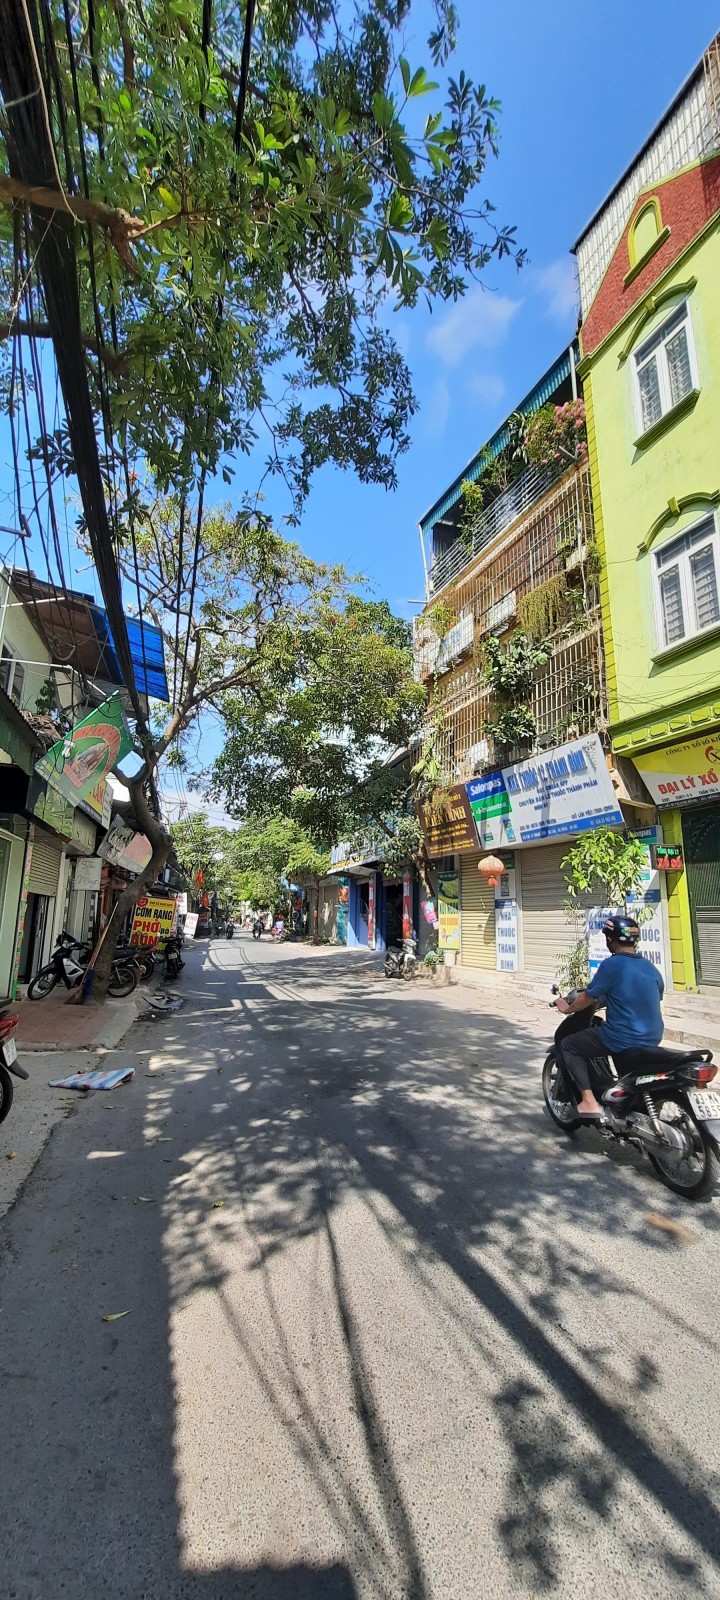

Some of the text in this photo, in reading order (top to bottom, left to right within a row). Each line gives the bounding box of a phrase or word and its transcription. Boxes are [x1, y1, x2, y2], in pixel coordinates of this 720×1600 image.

[519, 762, 539, 789] THUỐC
[545, 756, 570, 778] THANH
[567, 749, 587, 772] BÌNH
[470, 777, 502, 796] Salonpas
[583, 777, 598, 788] PHẨM
[658, 768, 719, 795] ĐẠI LÝ XỔ
[135, 906, 173, 920] CƠM RANG
[133, 919, 161, 933] PHỞ
[498, 925, 516, 938] THUỐC
[498, 943, 516, 954] THANH
